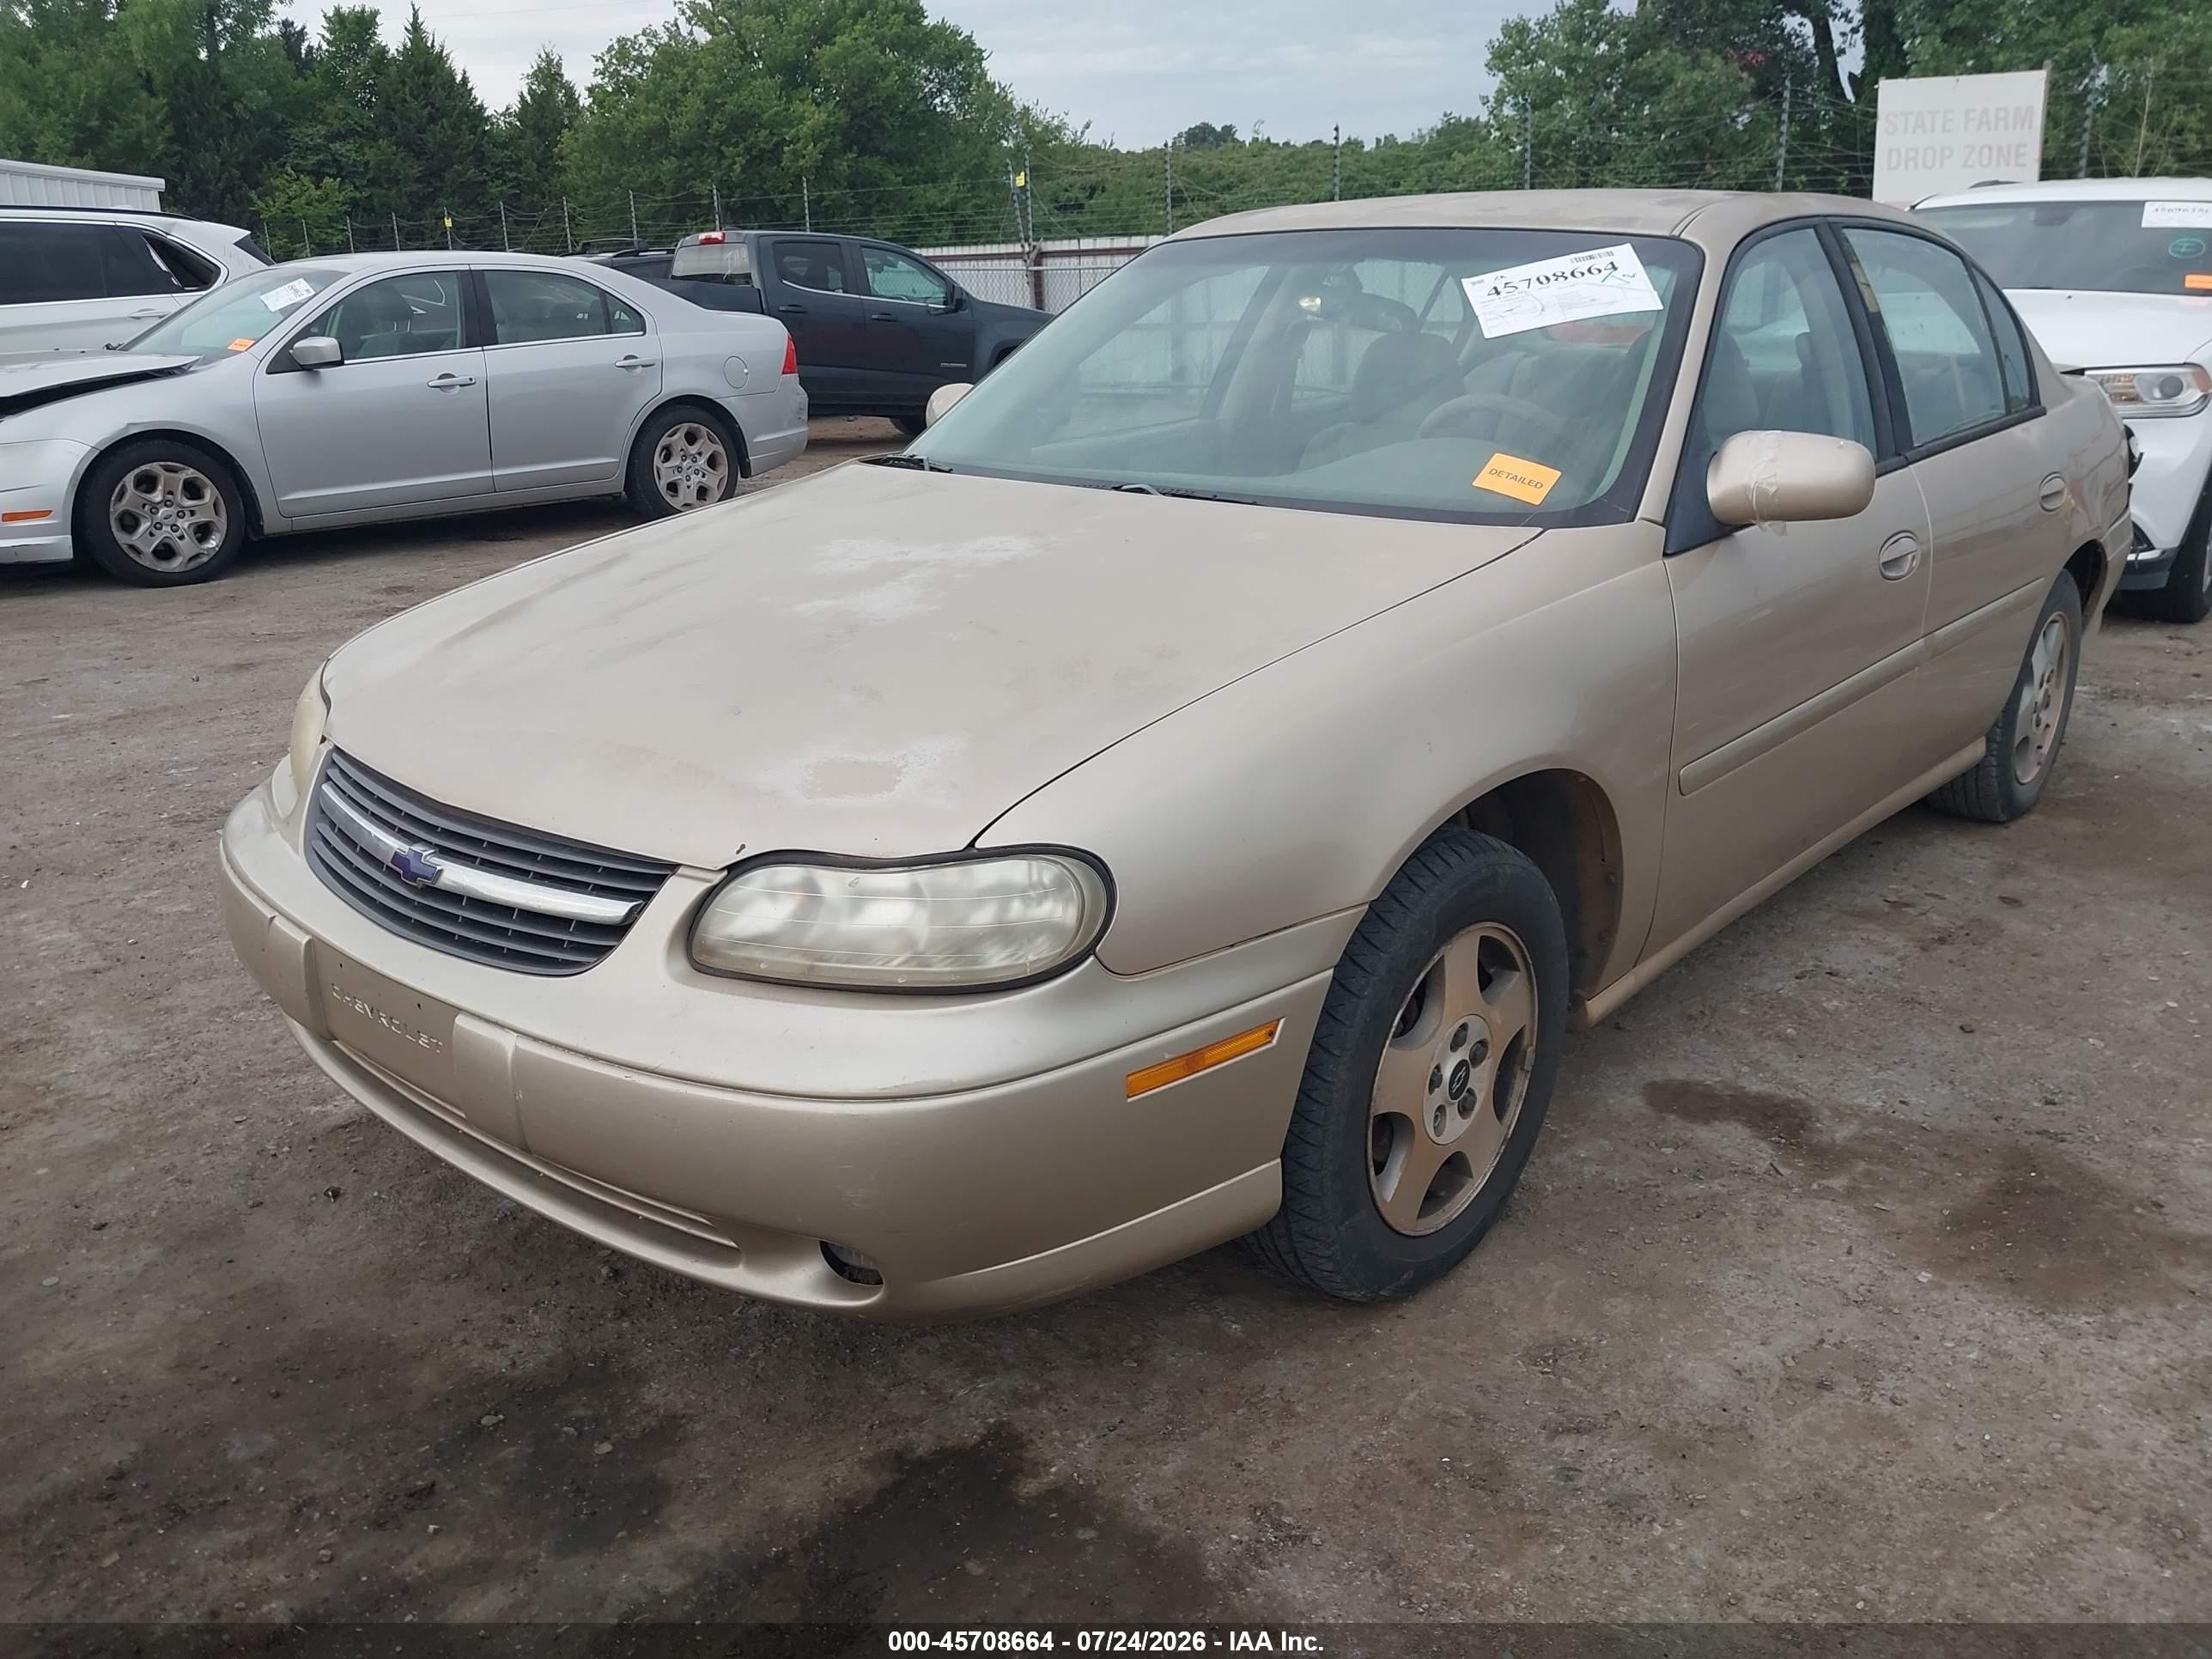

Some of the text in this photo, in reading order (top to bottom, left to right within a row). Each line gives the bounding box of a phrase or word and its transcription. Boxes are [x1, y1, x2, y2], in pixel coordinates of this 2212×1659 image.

[1885, 106, 2034, 136] STATE FARM
[1887, 143, 2027, 170] DROP ZONE
[1486, 260, 1620, 297] 45708664
[1488, 468, 1544, 489] DETAILED
